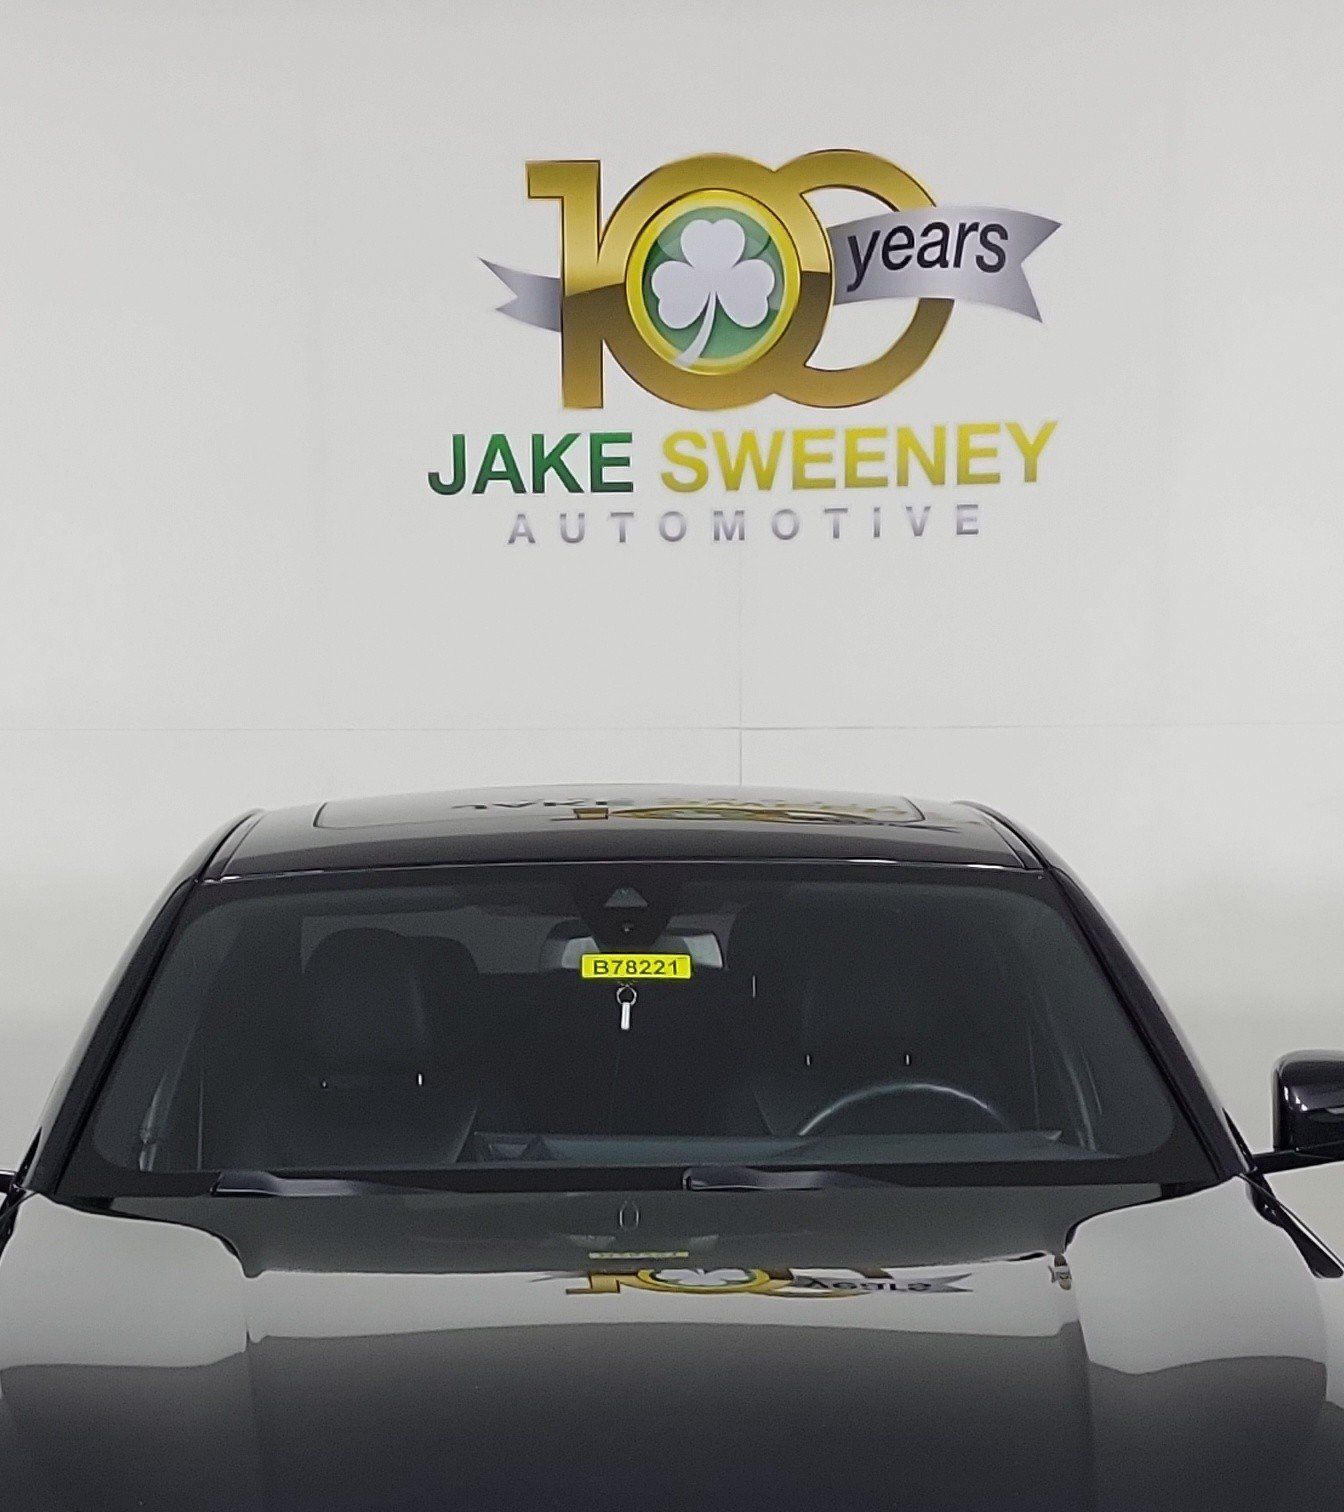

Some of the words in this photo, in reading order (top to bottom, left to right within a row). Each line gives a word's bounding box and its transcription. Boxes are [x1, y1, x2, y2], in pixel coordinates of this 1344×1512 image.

[525, 149, 956, 411] 100
[846, 219, 1010, 292] years
[427, 432, 634, 495] JAKE
[660, 421, 1058, 492] SWEENEY
[507, 504, 980, 544] AUTOMOTIVE
[593, 960, 678, 975] B78221
